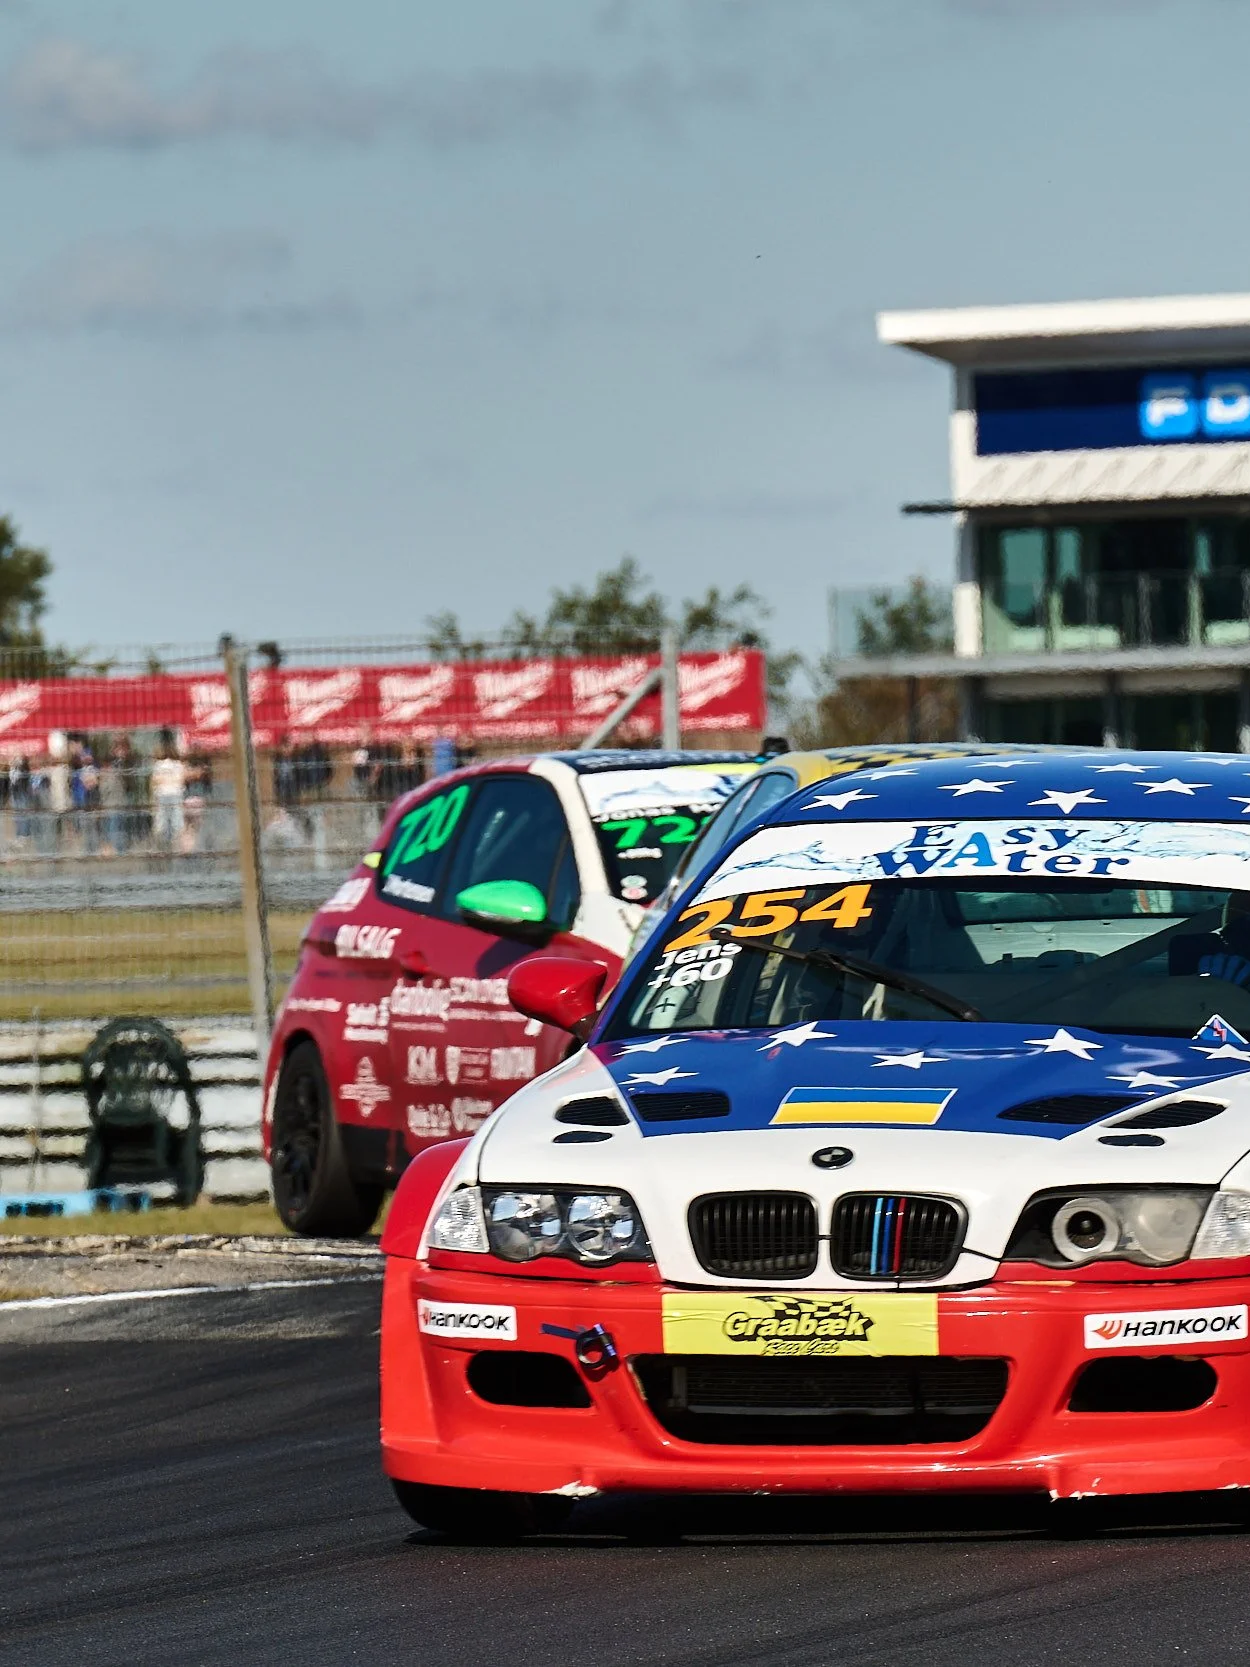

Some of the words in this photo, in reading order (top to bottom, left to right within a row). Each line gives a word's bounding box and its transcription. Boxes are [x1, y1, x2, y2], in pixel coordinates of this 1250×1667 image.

[382, 784, 471, 878] 720
[600, 815, 712, 849] 72
[663, 884, 873, 953] 254
[647, 957, 734, 989] +60
[653, 942, 743, 971] Jens
